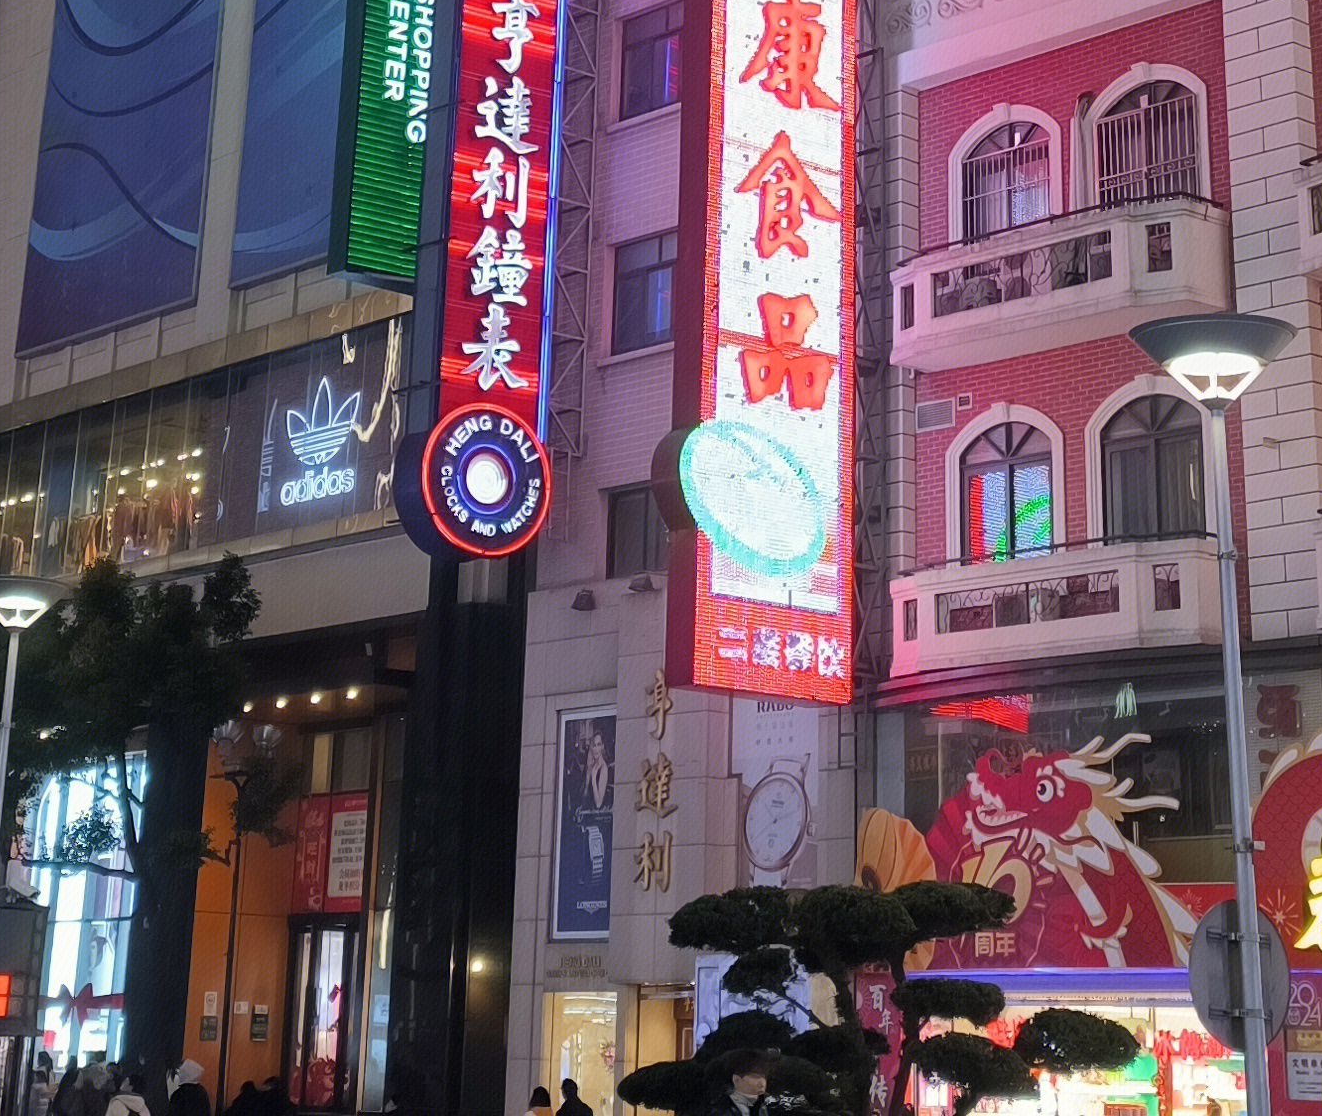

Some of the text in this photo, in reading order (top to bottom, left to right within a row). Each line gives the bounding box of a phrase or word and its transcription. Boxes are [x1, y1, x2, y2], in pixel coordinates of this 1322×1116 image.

[444, 414, 540, 463] HENG DALI
[280, 467, 355, 506] adidas
[471, 519, 497, 537] AND
[975, 932, 1016, 957] 周年
[869, 984, 894, 1035] 百年
